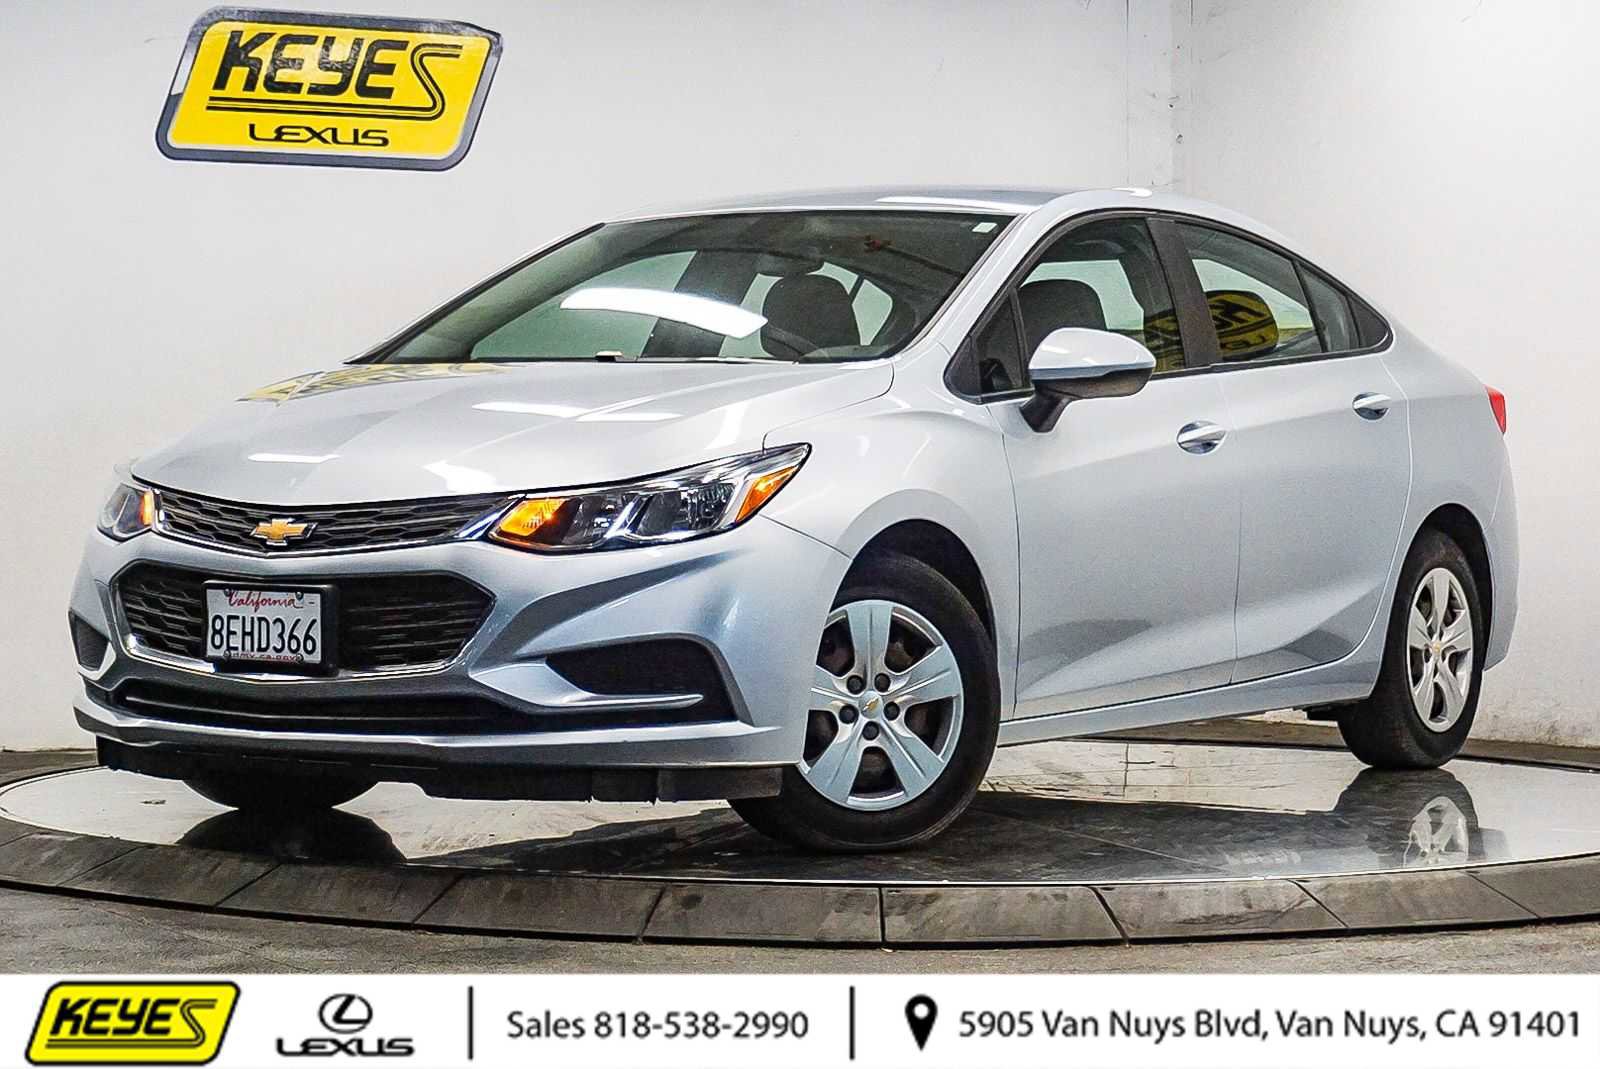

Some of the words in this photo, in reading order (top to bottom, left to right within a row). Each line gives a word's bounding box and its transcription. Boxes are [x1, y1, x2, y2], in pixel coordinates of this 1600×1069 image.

[206, 30, 463, 121] KEYES
[249, 123, 390, 147] LEXUS
[228, 591, 303, 613] California
[211, 614, 318, 655] 8EHD366
